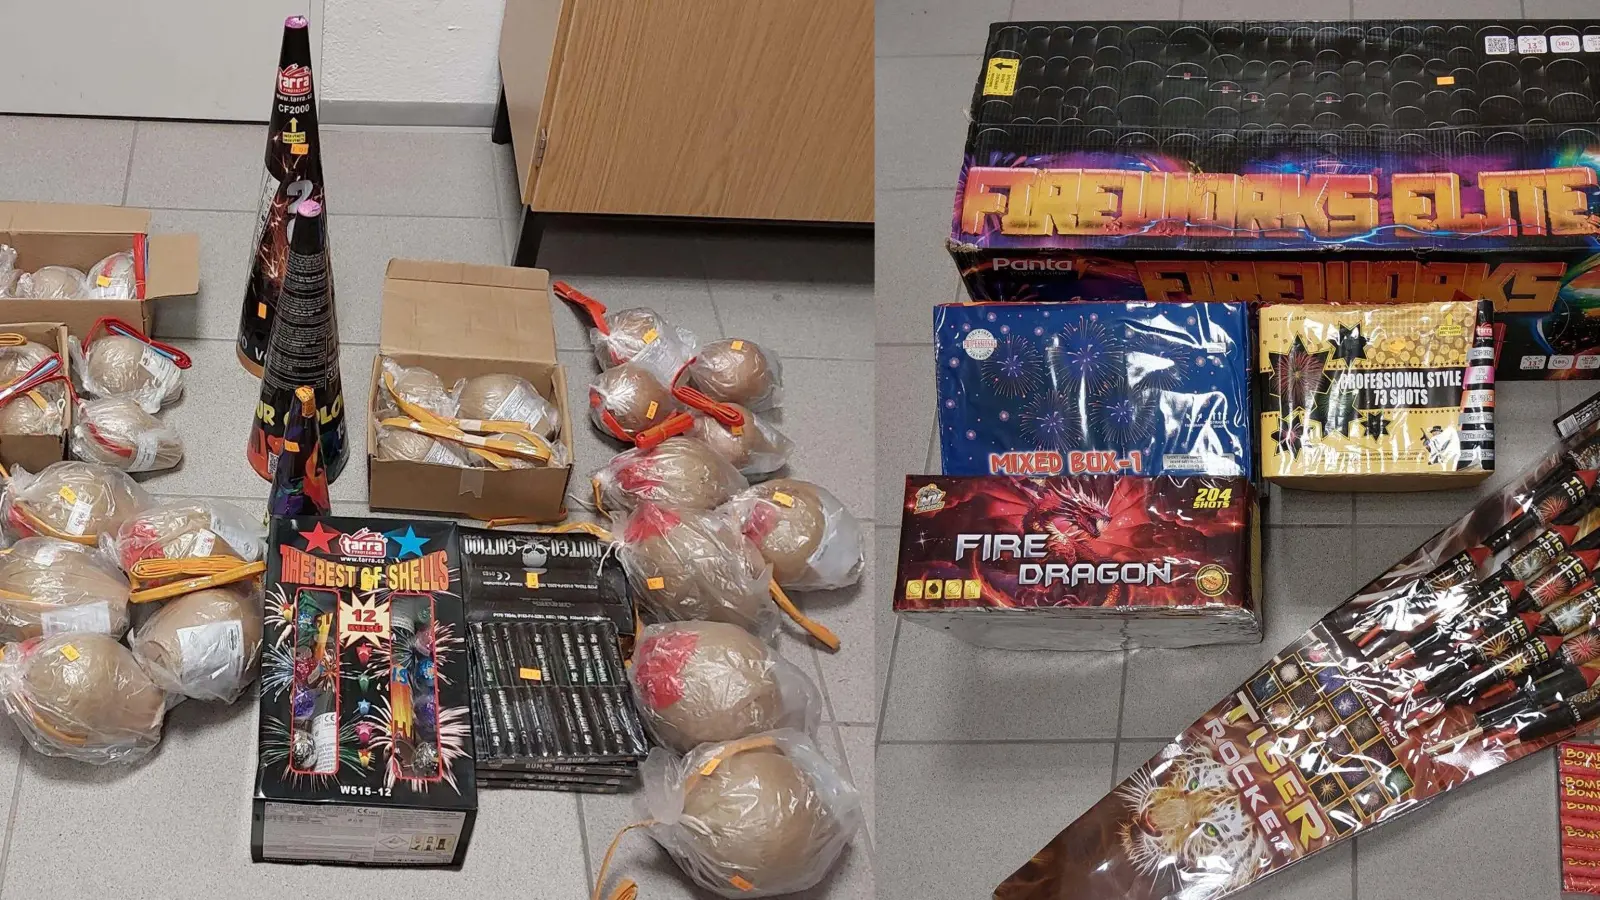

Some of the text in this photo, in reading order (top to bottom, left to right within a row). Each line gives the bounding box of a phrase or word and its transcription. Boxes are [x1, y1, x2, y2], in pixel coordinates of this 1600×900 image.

[279, 75, 310, 90] tarra
[278, 103, 310, 114] CF2000
[961, 166, 1598, 239] FIREWORKS ELITE
[992, 257, 1073, 272] Panta
[1134, 259, 1568, 312] FIREWORKS
[1340, 371, 1462, 389] PROFESSIONAL STYLE
[1373, 389, 1429, 406] 73 SHOTS
[991, 451, 1064, 475] MIXED
[1069, 450, 1143, 475] BOX-1
[1195, 487, 1232, 502] 204
[1193, 500, 1230, 509] SHOTS
[342, 537, 383, 552] tarra
[955, 533, 1050, 561] FIRE
[280, 544, 313, 585] THE
[314, 558, 357, 589] BEST
[386, 550, 450, 592] SHELLS
[340, 556, 385, 564] www.tarra.cz
[1018, 563, 1172, 588] DRAGON
[351, 609, 377, 623] 12
[1376, 716, 1399, 746] effects
[1224, 690, 1327, 851] TIGER
[340, 785, 392, 797] W515-12
[1204, 717, 1296, 857] ROCKET
